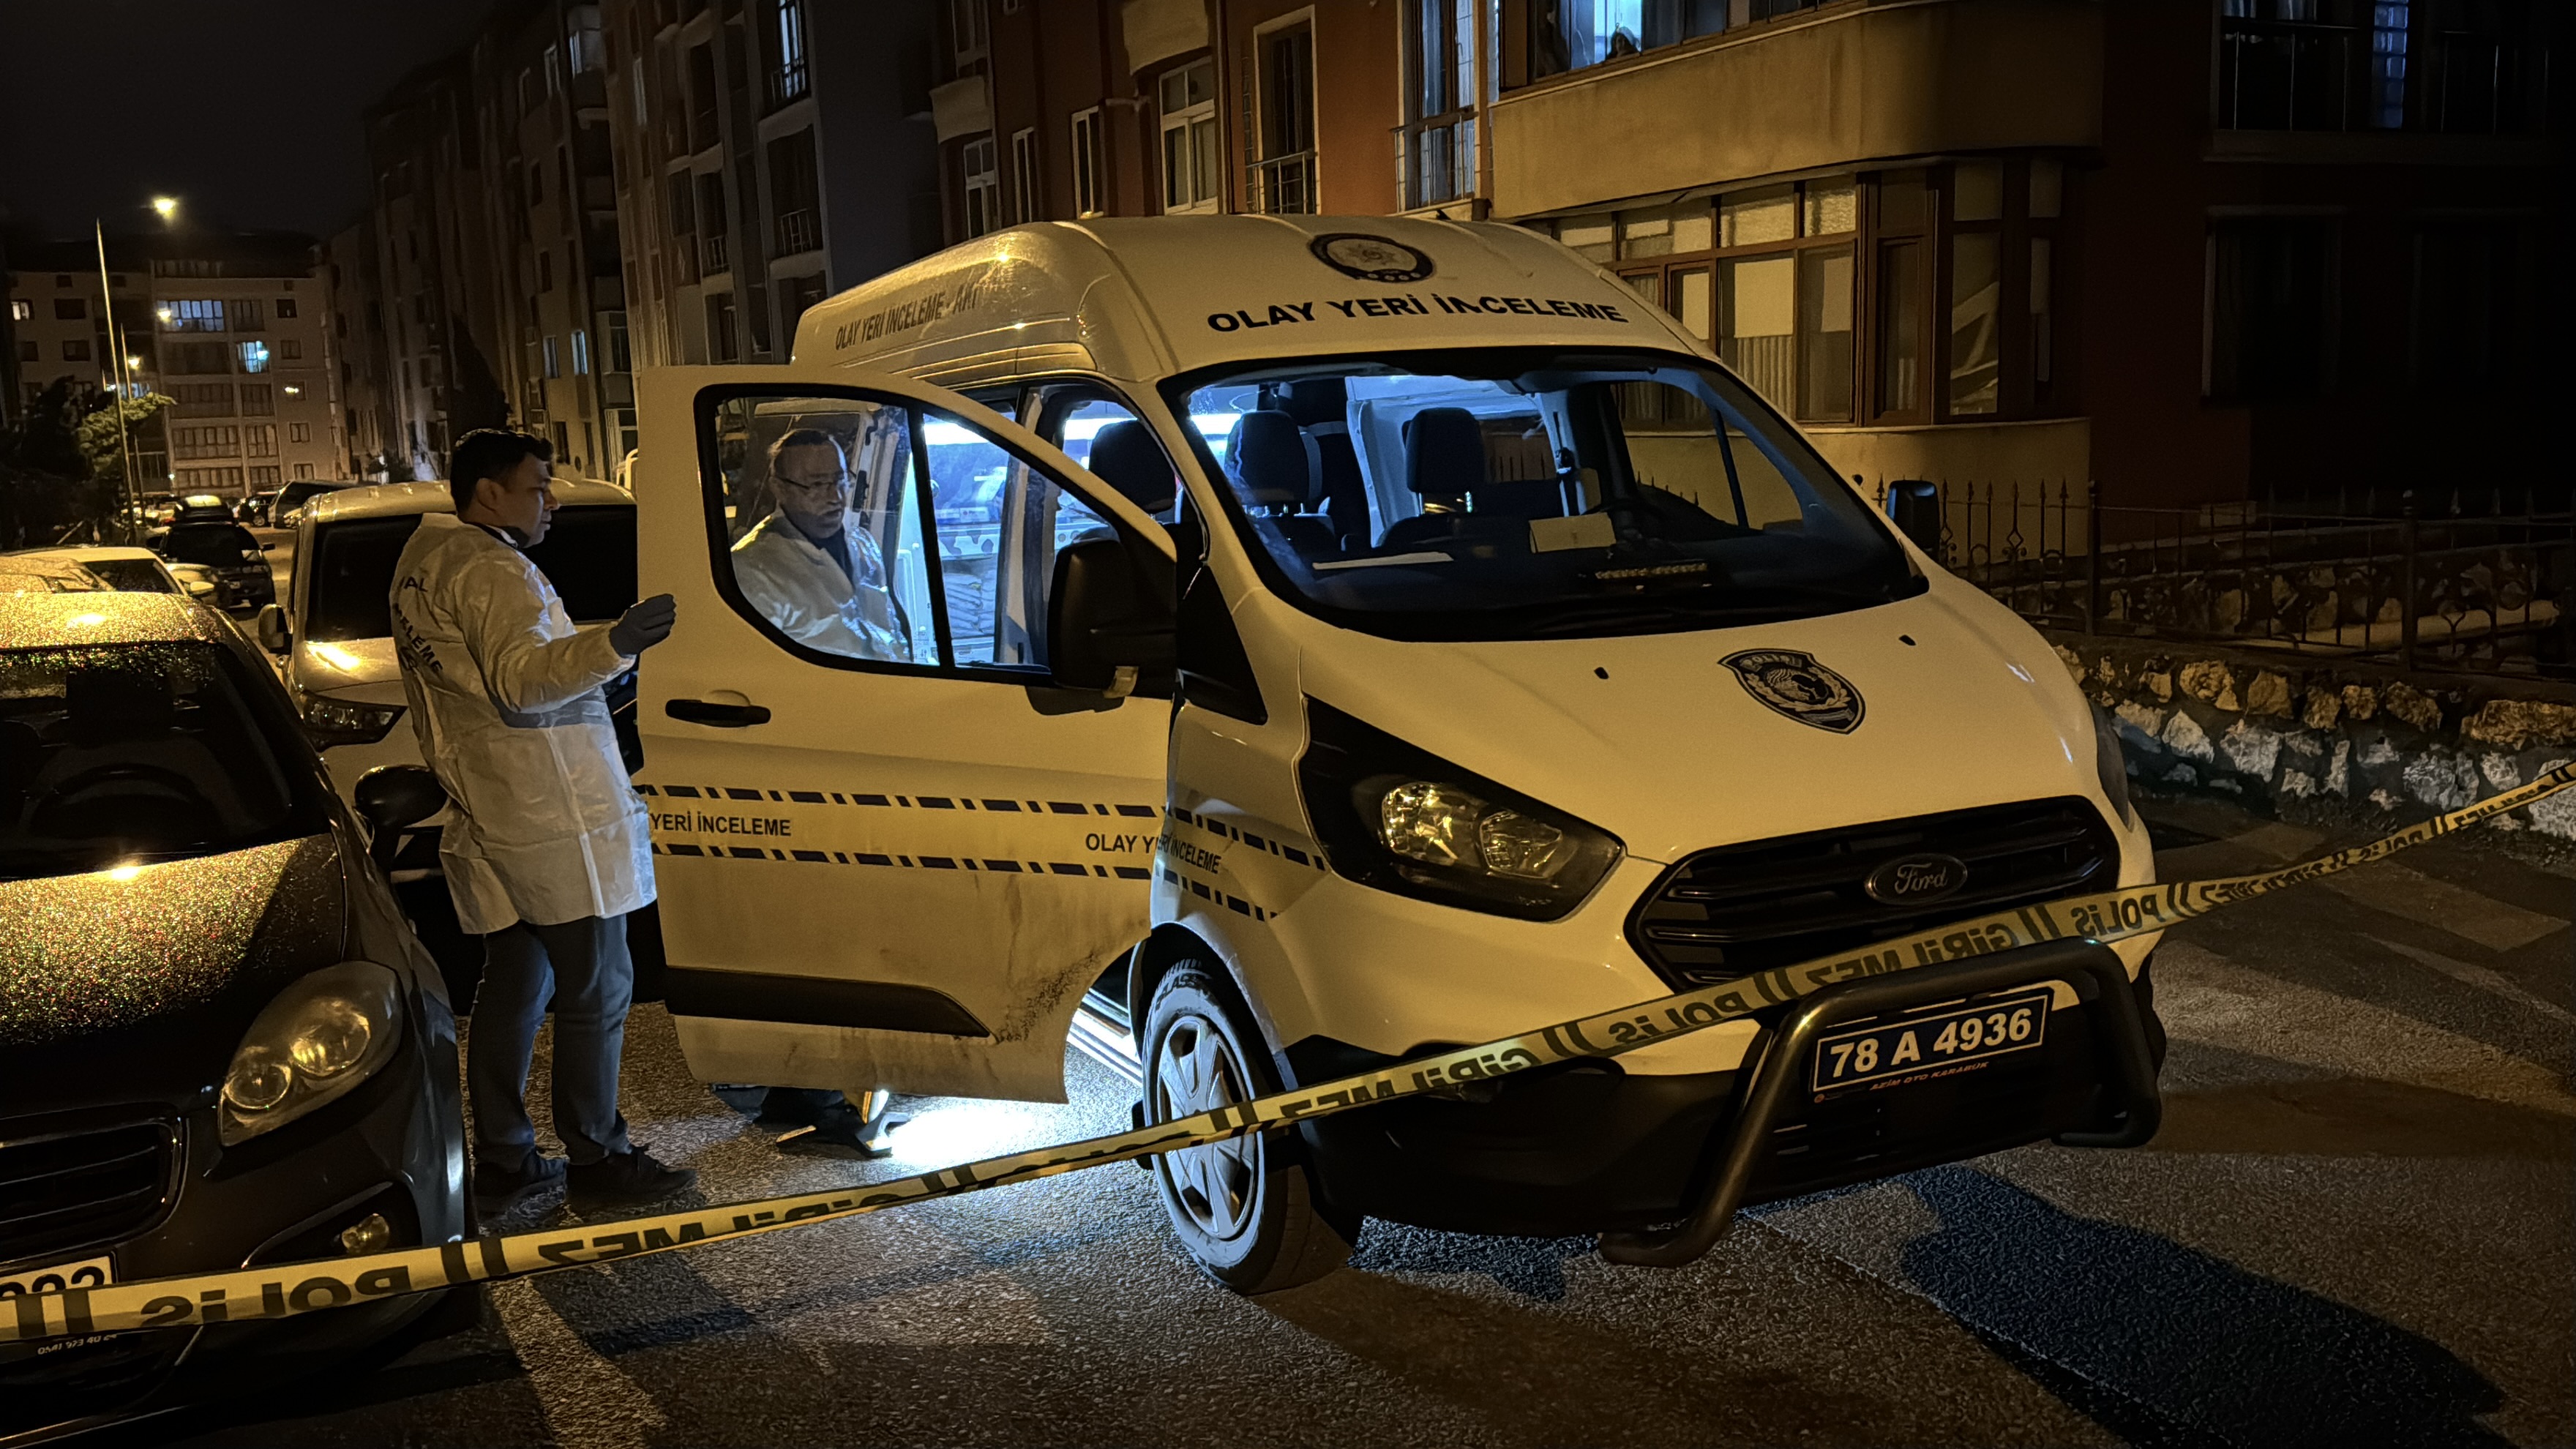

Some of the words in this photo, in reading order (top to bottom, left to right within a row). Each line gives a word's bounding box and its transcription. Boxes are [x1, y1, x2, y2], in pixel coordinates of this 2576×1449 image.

[1208, 302, 1316, 332] OLAY
[1327, 293, 1430, 318] YERİ
[1431, 293, 1629, 323] İNCELEME
[835, 320, 861, 351] OLAY
[650, 810, 692, 832] YERİ
[697, 811, 791, 836] İNCELEME
[1085, 833, 1138, 853] OLAY
[1895, 862, 1947, 894] Ford
[1830, 1038, 1879, 1078] 78
[1890, 1030, 1921, 1066] A
[1933, 1008, 2032, 1055] 4936
